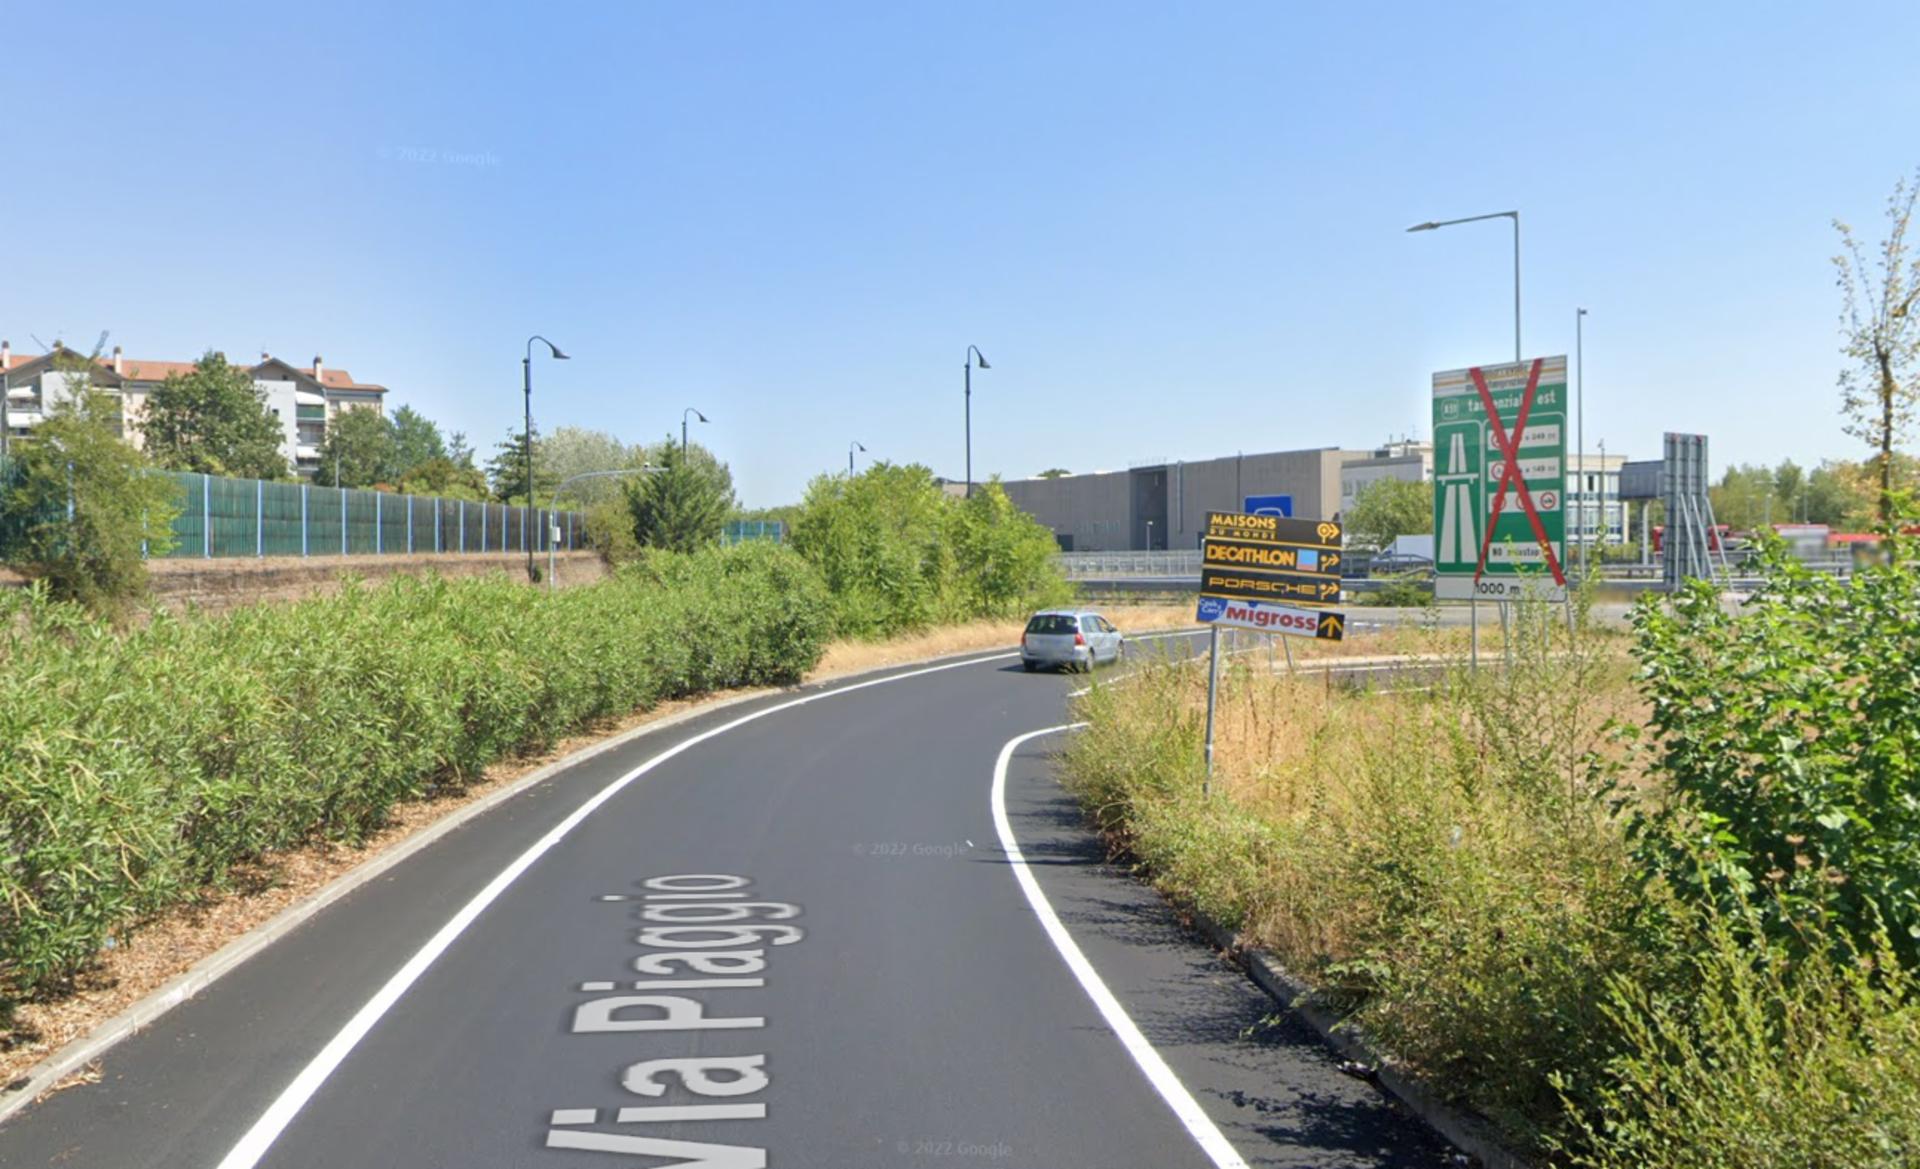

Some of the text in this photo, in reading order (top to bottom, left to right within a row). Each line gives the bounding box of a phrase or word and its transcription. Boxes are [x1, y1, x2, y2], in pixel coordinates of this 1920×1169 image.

[1536, 391, 1556, 405] est
[1211, 514, 1277, 529] MAISONS
[1206, 545, 1295, 567] DECATHLON
[1208, 577, 1317, 595] PORSCHE
[1476, 583, 1520, 594] 1000 m
[1226, 607, 1317, 631] Migross
